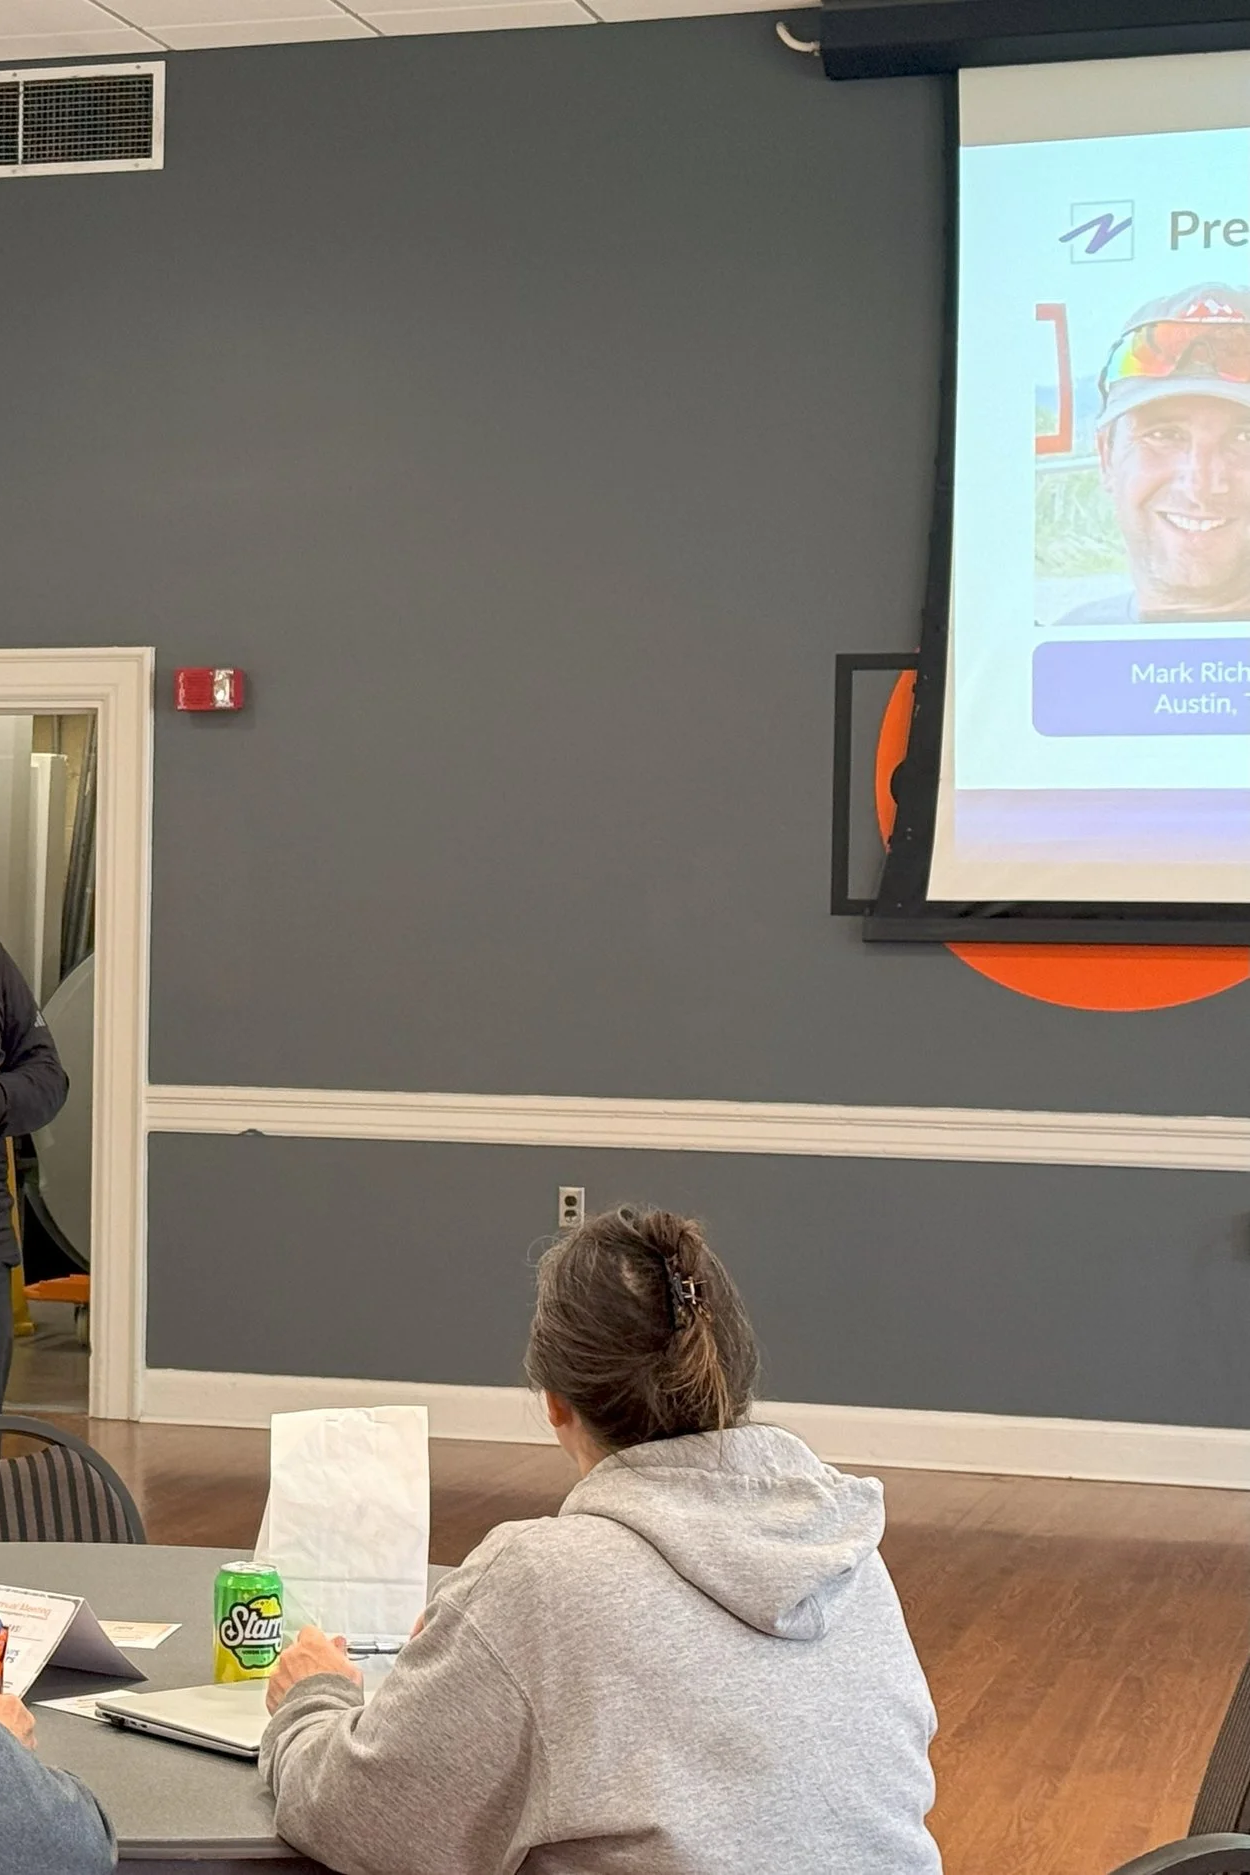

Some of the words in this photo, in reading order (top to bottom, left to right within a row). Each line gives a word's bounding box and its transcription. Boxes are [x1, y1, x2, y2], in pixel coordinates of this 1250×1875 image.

[1170, 210, 1250, 250] Pre
[1132, 661, 1194, 684] Mark
[1200, 660, 1250, 683] Rich
[1153, 693, 1238, 716] Austin,
